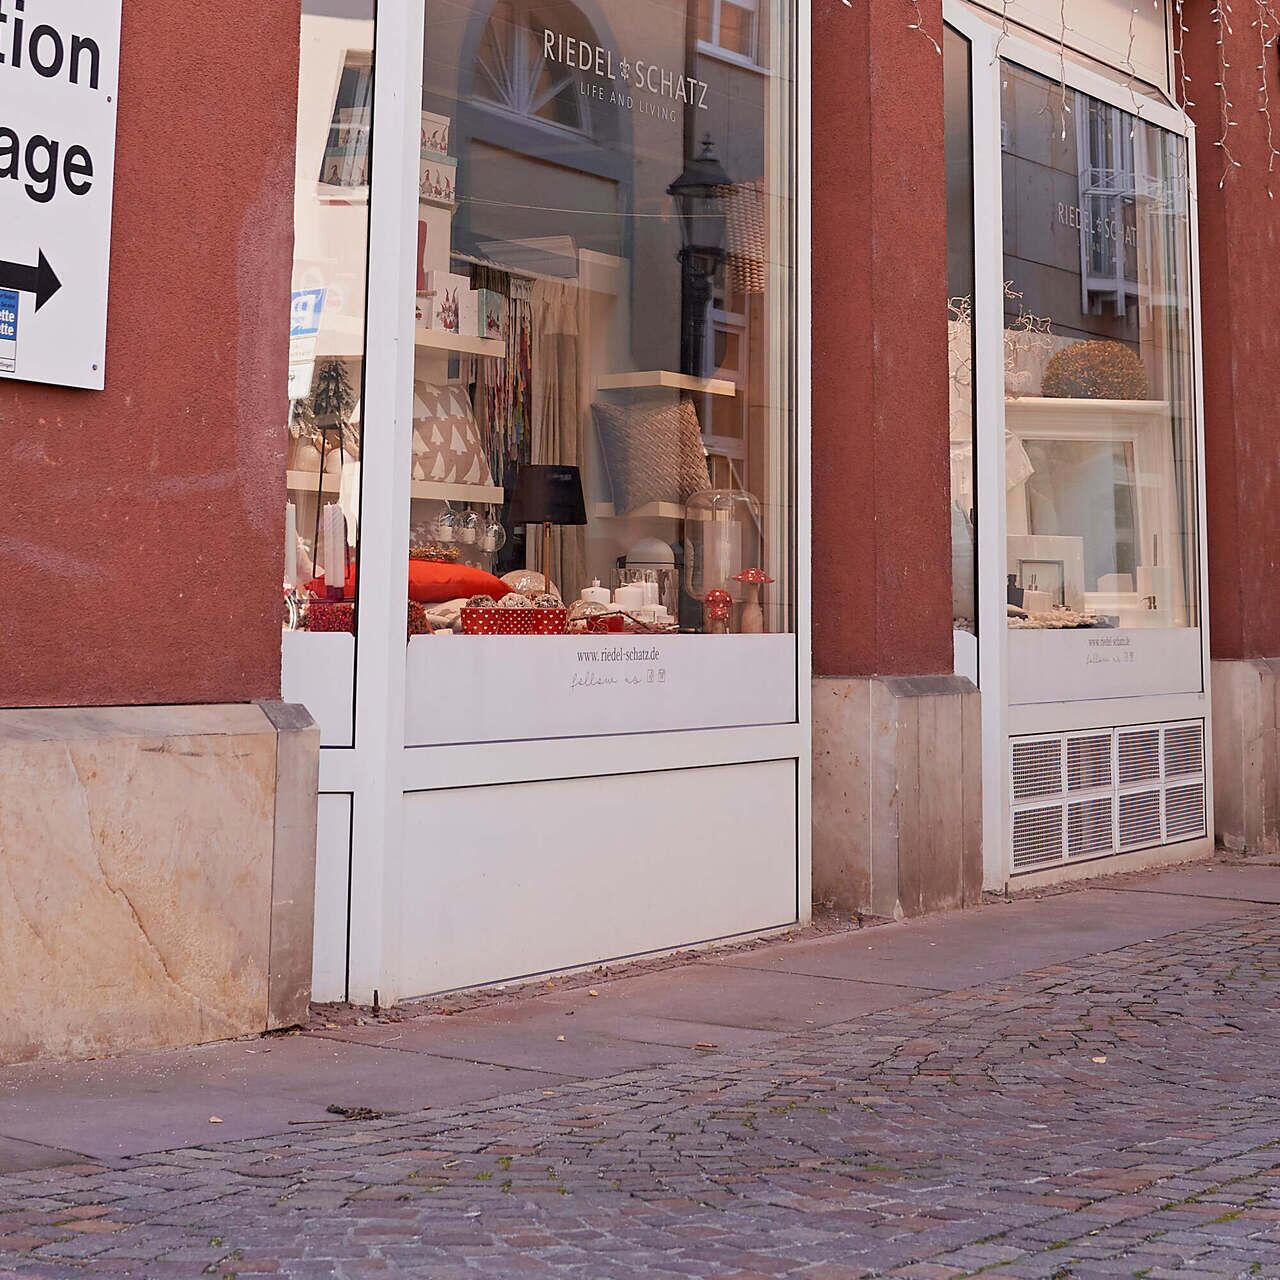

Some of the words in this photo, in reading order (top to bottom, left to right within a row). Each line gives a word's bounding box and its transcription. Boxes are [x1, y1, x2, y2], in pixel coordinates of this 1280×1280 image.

[543, 29, 616, 80] RIEDEL
[635, 60, 708, 110] SCHATZ
[580, 81, 604, 100] LIFE
[610, 91, 633, 109] AND
[639, 100, 676, 122] LIVING
